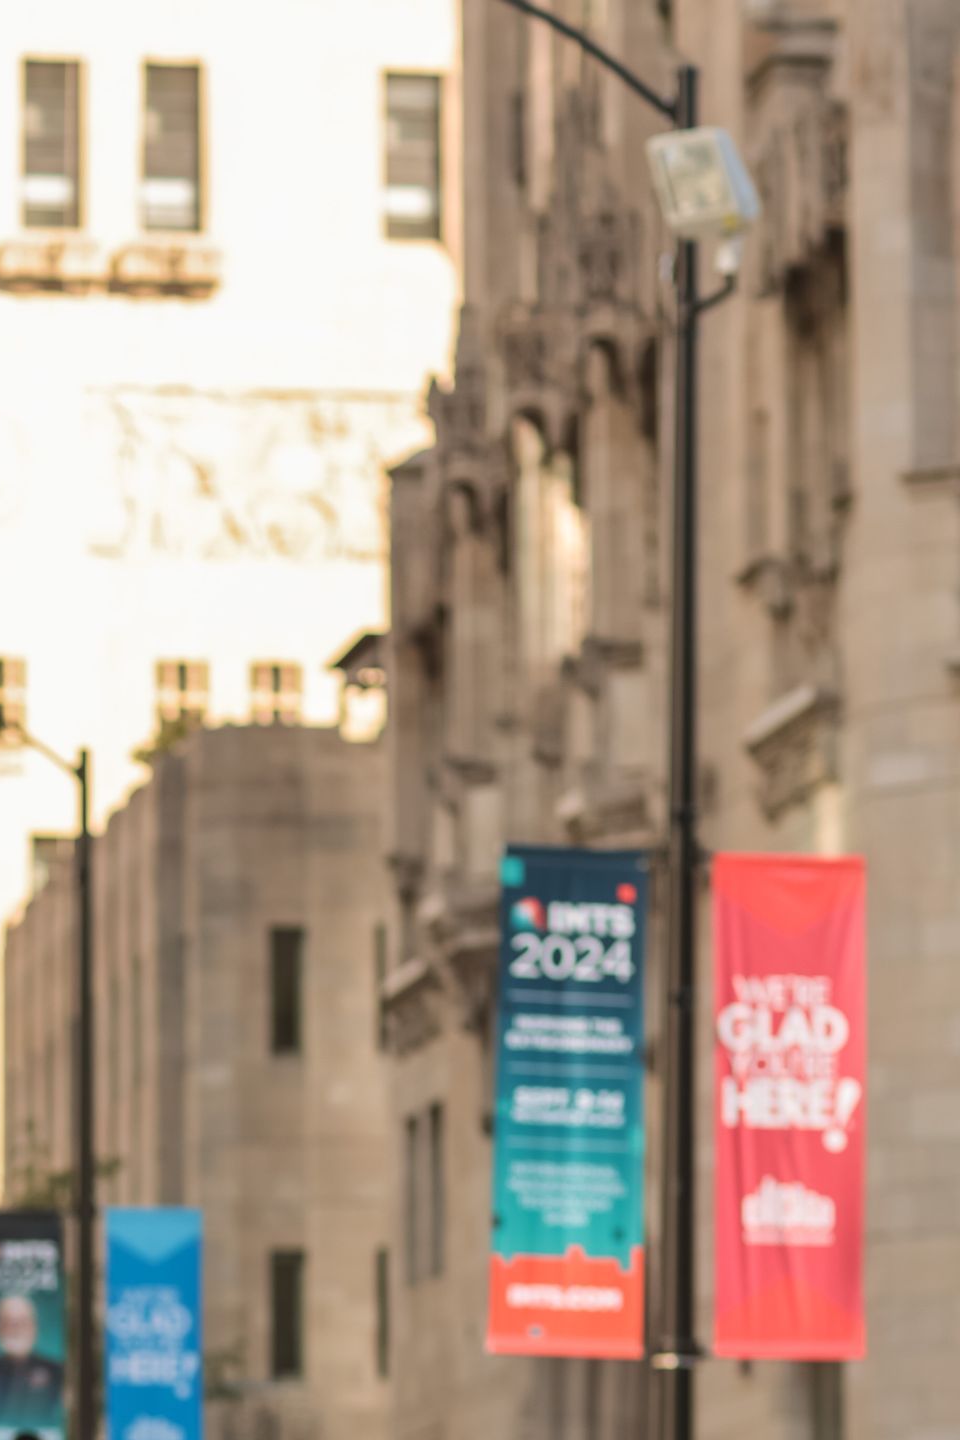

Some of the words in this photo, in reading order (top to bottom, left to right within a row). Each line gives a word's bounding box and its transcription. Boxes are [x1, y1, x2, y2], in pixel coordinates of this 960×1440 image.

[509, 931, 635, 983] 2024
[732, 973, 832, 1011] WE'RE
[716, 1001, 850, 1053] GLAD
[721, 1076, 862, 1150] HERE!
